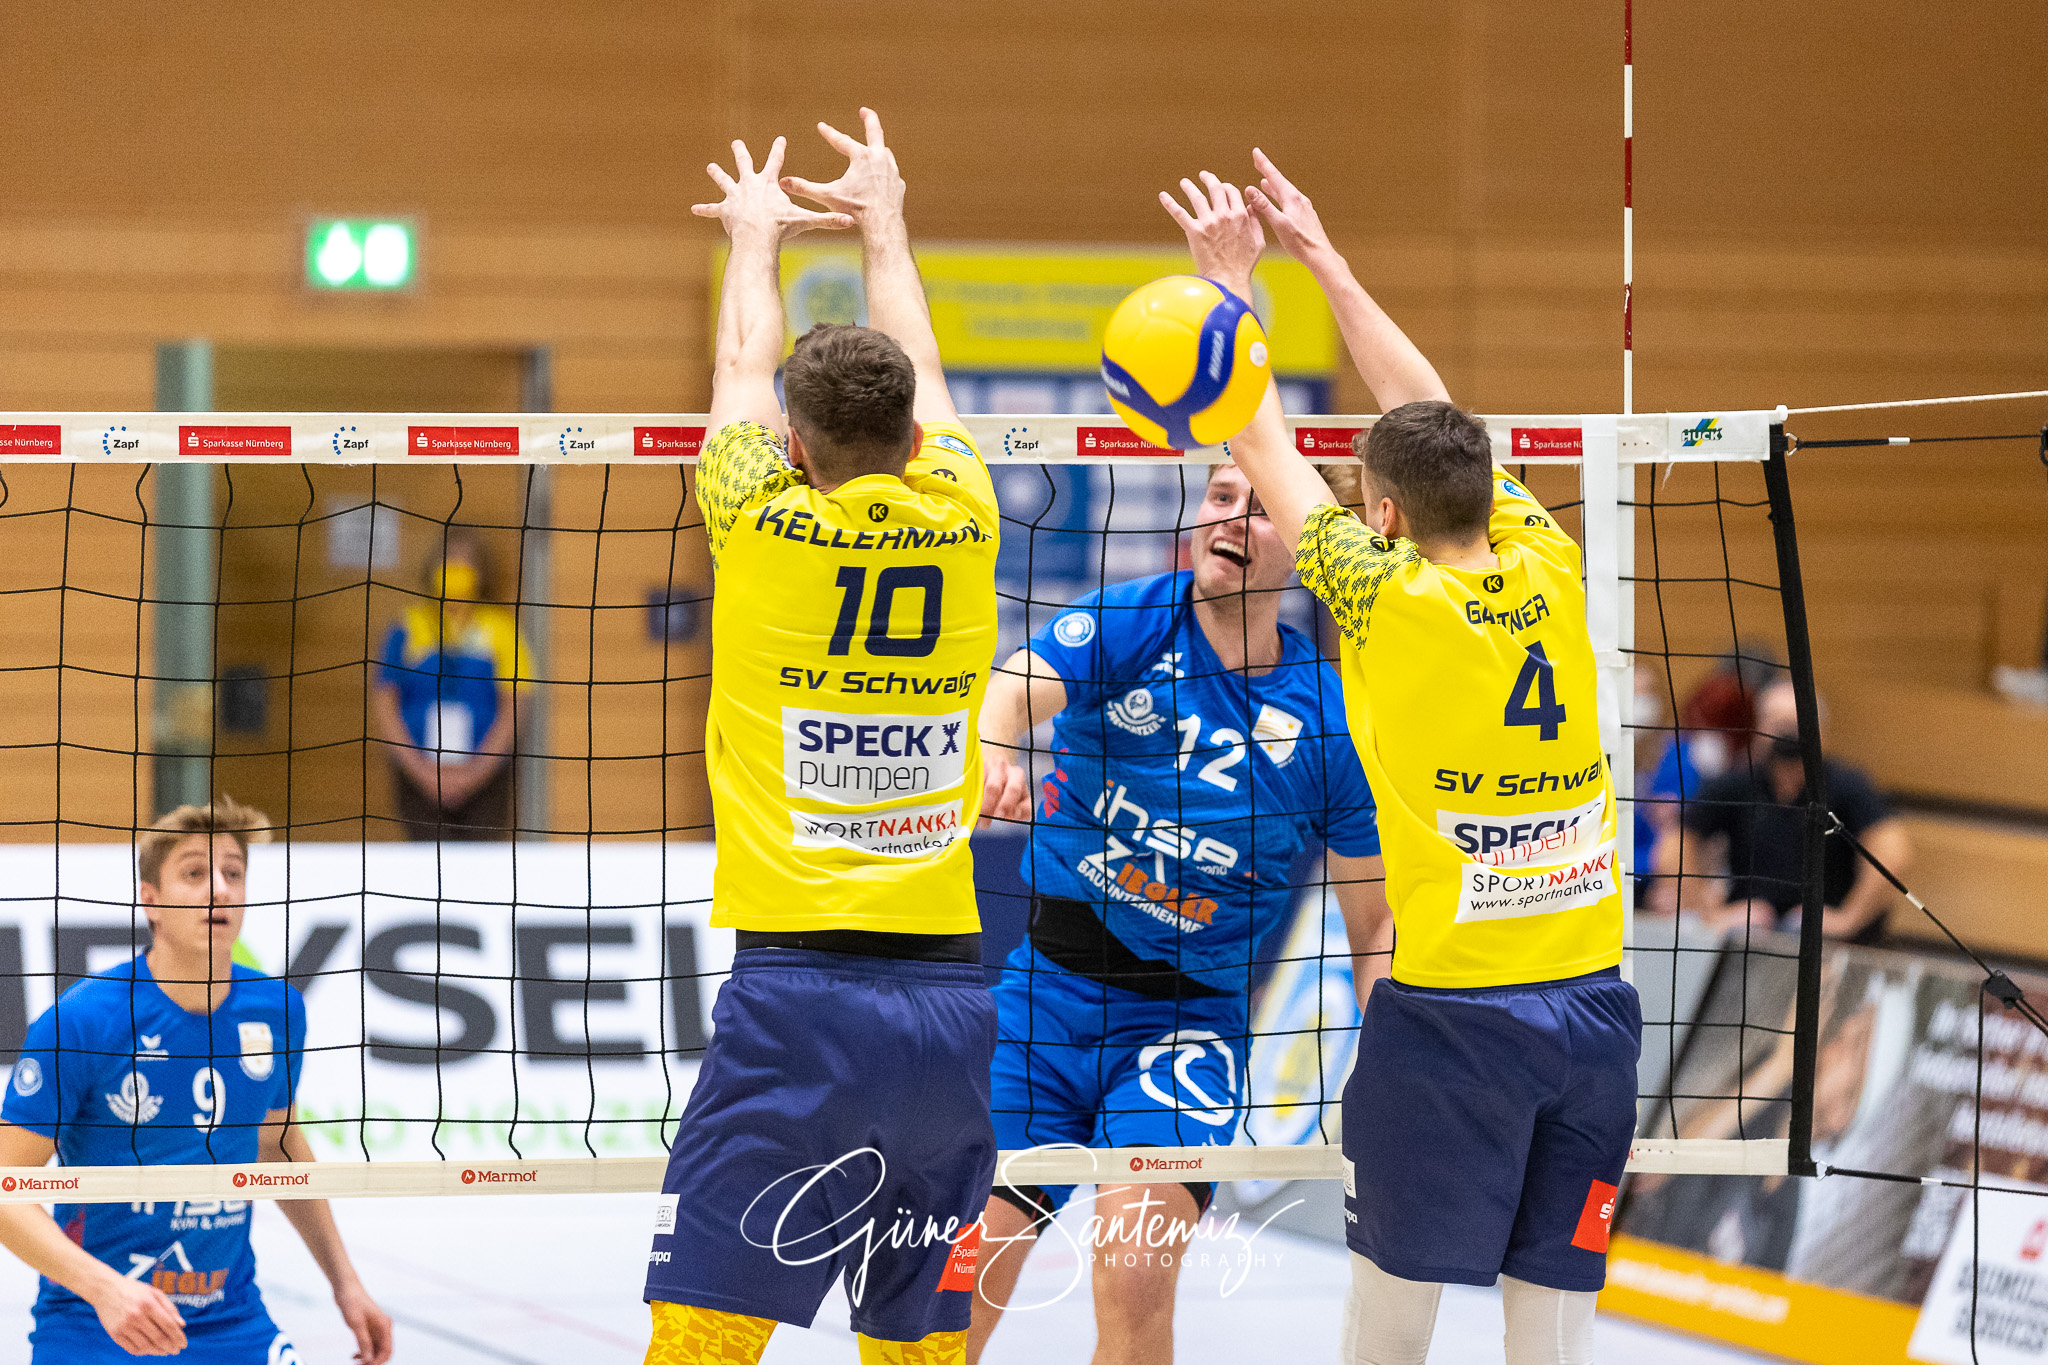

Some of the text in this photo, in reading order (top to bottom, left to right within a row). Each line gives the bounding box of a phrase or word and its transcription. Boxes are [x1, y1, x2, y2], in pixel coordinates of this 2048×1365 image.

[1681, 428, 1723, 442] HUCK
[113, 439, 140, 450] Zapf
[203, 439, 284, 450] Sparkasse Nürnberg
[343, 439, 369, 450] Zapf
[431, 439, 511, 450] Sparkasse Nürnberg
[569, 439, 595, 451] Zapf
[657, 439, 697, 450] Sparkasse
[1014, 440, 1039, 450] Zapf
[1099, 440, 1139, 450] Sparkasse
[1318, 440, 1352, 450] Sparkass
[1533, 440, 1572, 450] Sparkasse
[754, 505, 993, 550] KELLERMAN
[827, 564, 943, 658] 10
[780, 666, 977, 698] SV Schwaig
[1503, 639, 1567, 742] 4
[798, 719, 934, 757] SPECK
[1173, 713, 1246, 792] 12
[799, 760, 929, 798] pumpen
[1434, 768, 1485, 794] SV
[192, 1066, 227, 1134] 9
[1145, 1157, 1204, 1171] Marmot
[249, 1172, 310, 1186] Marmot
[477, 1168, 539, 1183] Marmot
[18, 1176, 80, 1190] Marmot
